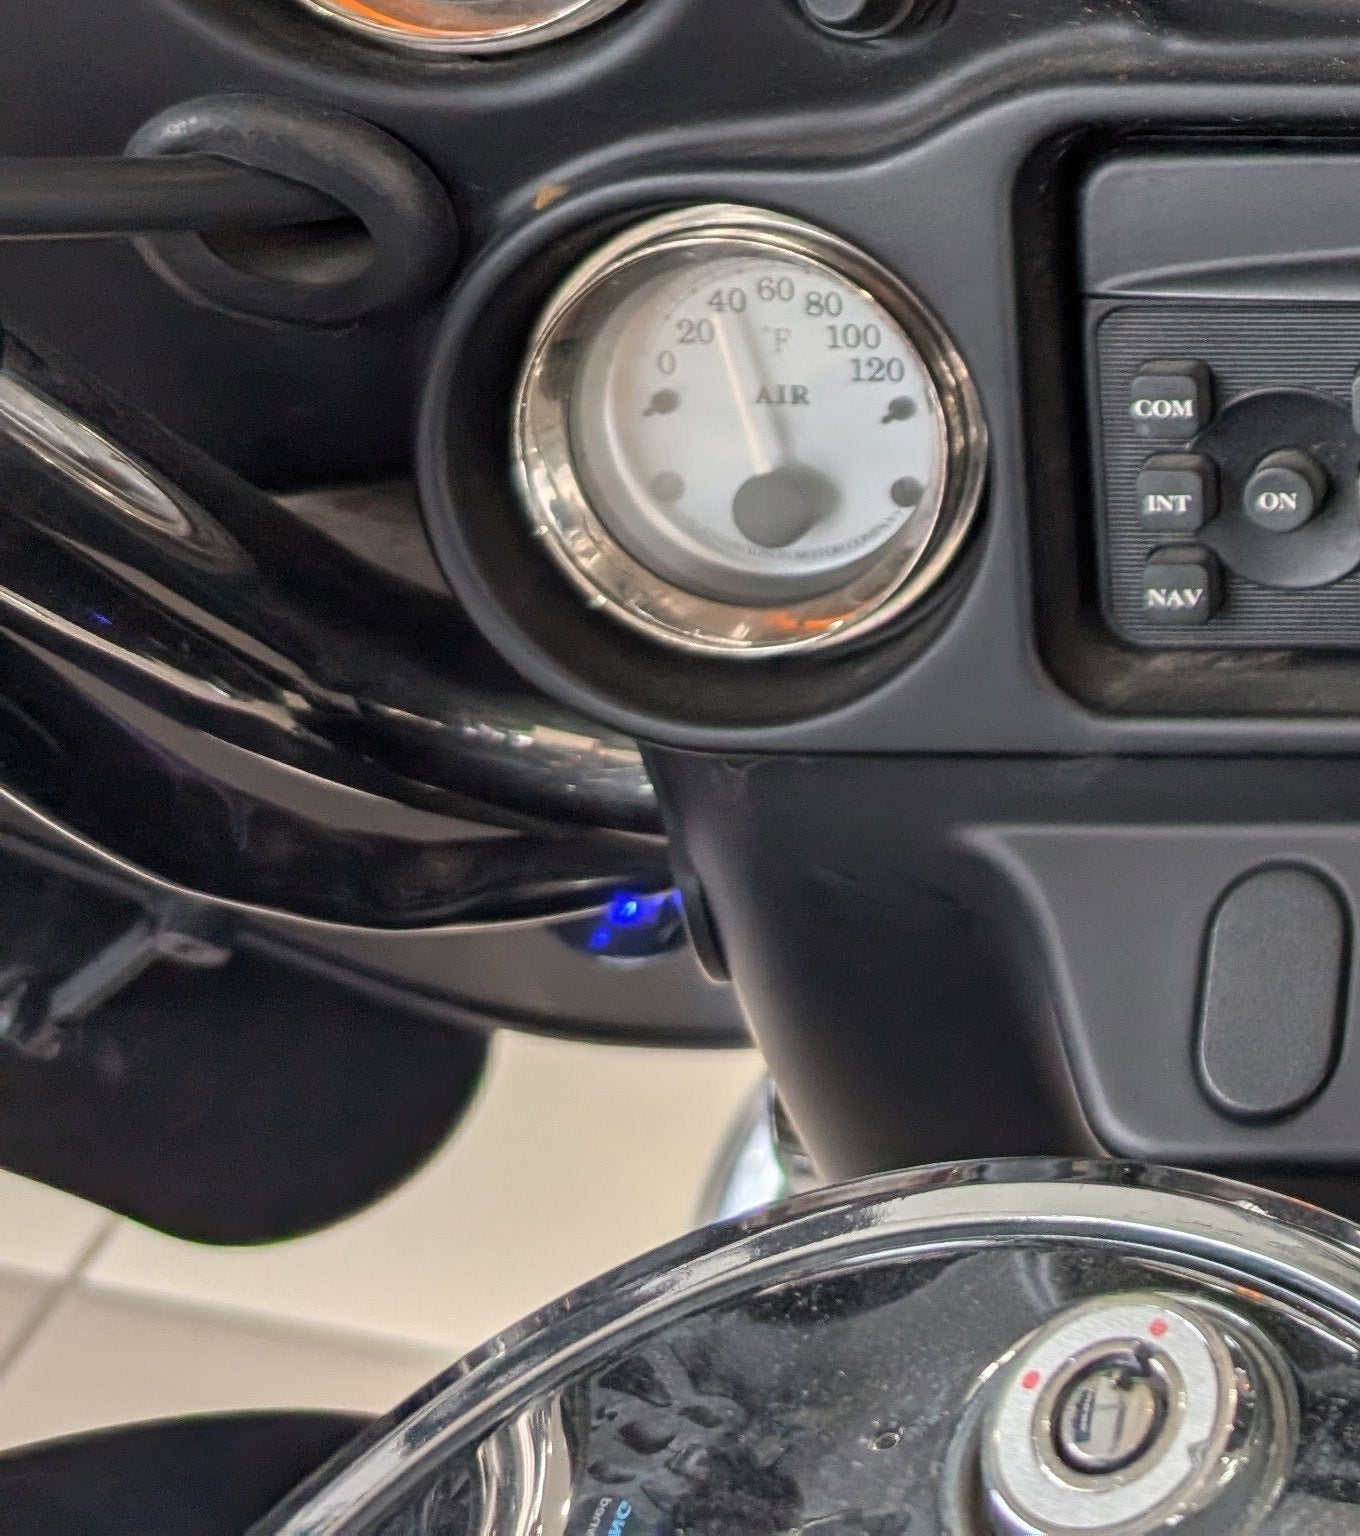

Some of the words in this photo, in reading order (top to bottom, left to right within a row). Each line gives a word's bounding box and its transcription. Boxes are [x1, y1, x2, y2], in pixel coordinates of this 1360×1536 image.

[708, 288, 747, 314] 40
[757, 276, 795, 302] 60
[805, 291, 843, 317] 80
[677, 318, 715, 344] 20
[826, 324, 881, 350] 100
[657, 350, 676, 375] 0
[849, 356, 905, 383] 120
[755, 383, 811, 405] AIR
[1132, 398, 1194, 419] COM
[1146, 493, 1192, 513] INT
[1257, 491, 1298, 512] ON
[1146, 587, 1203, 608] NAV
